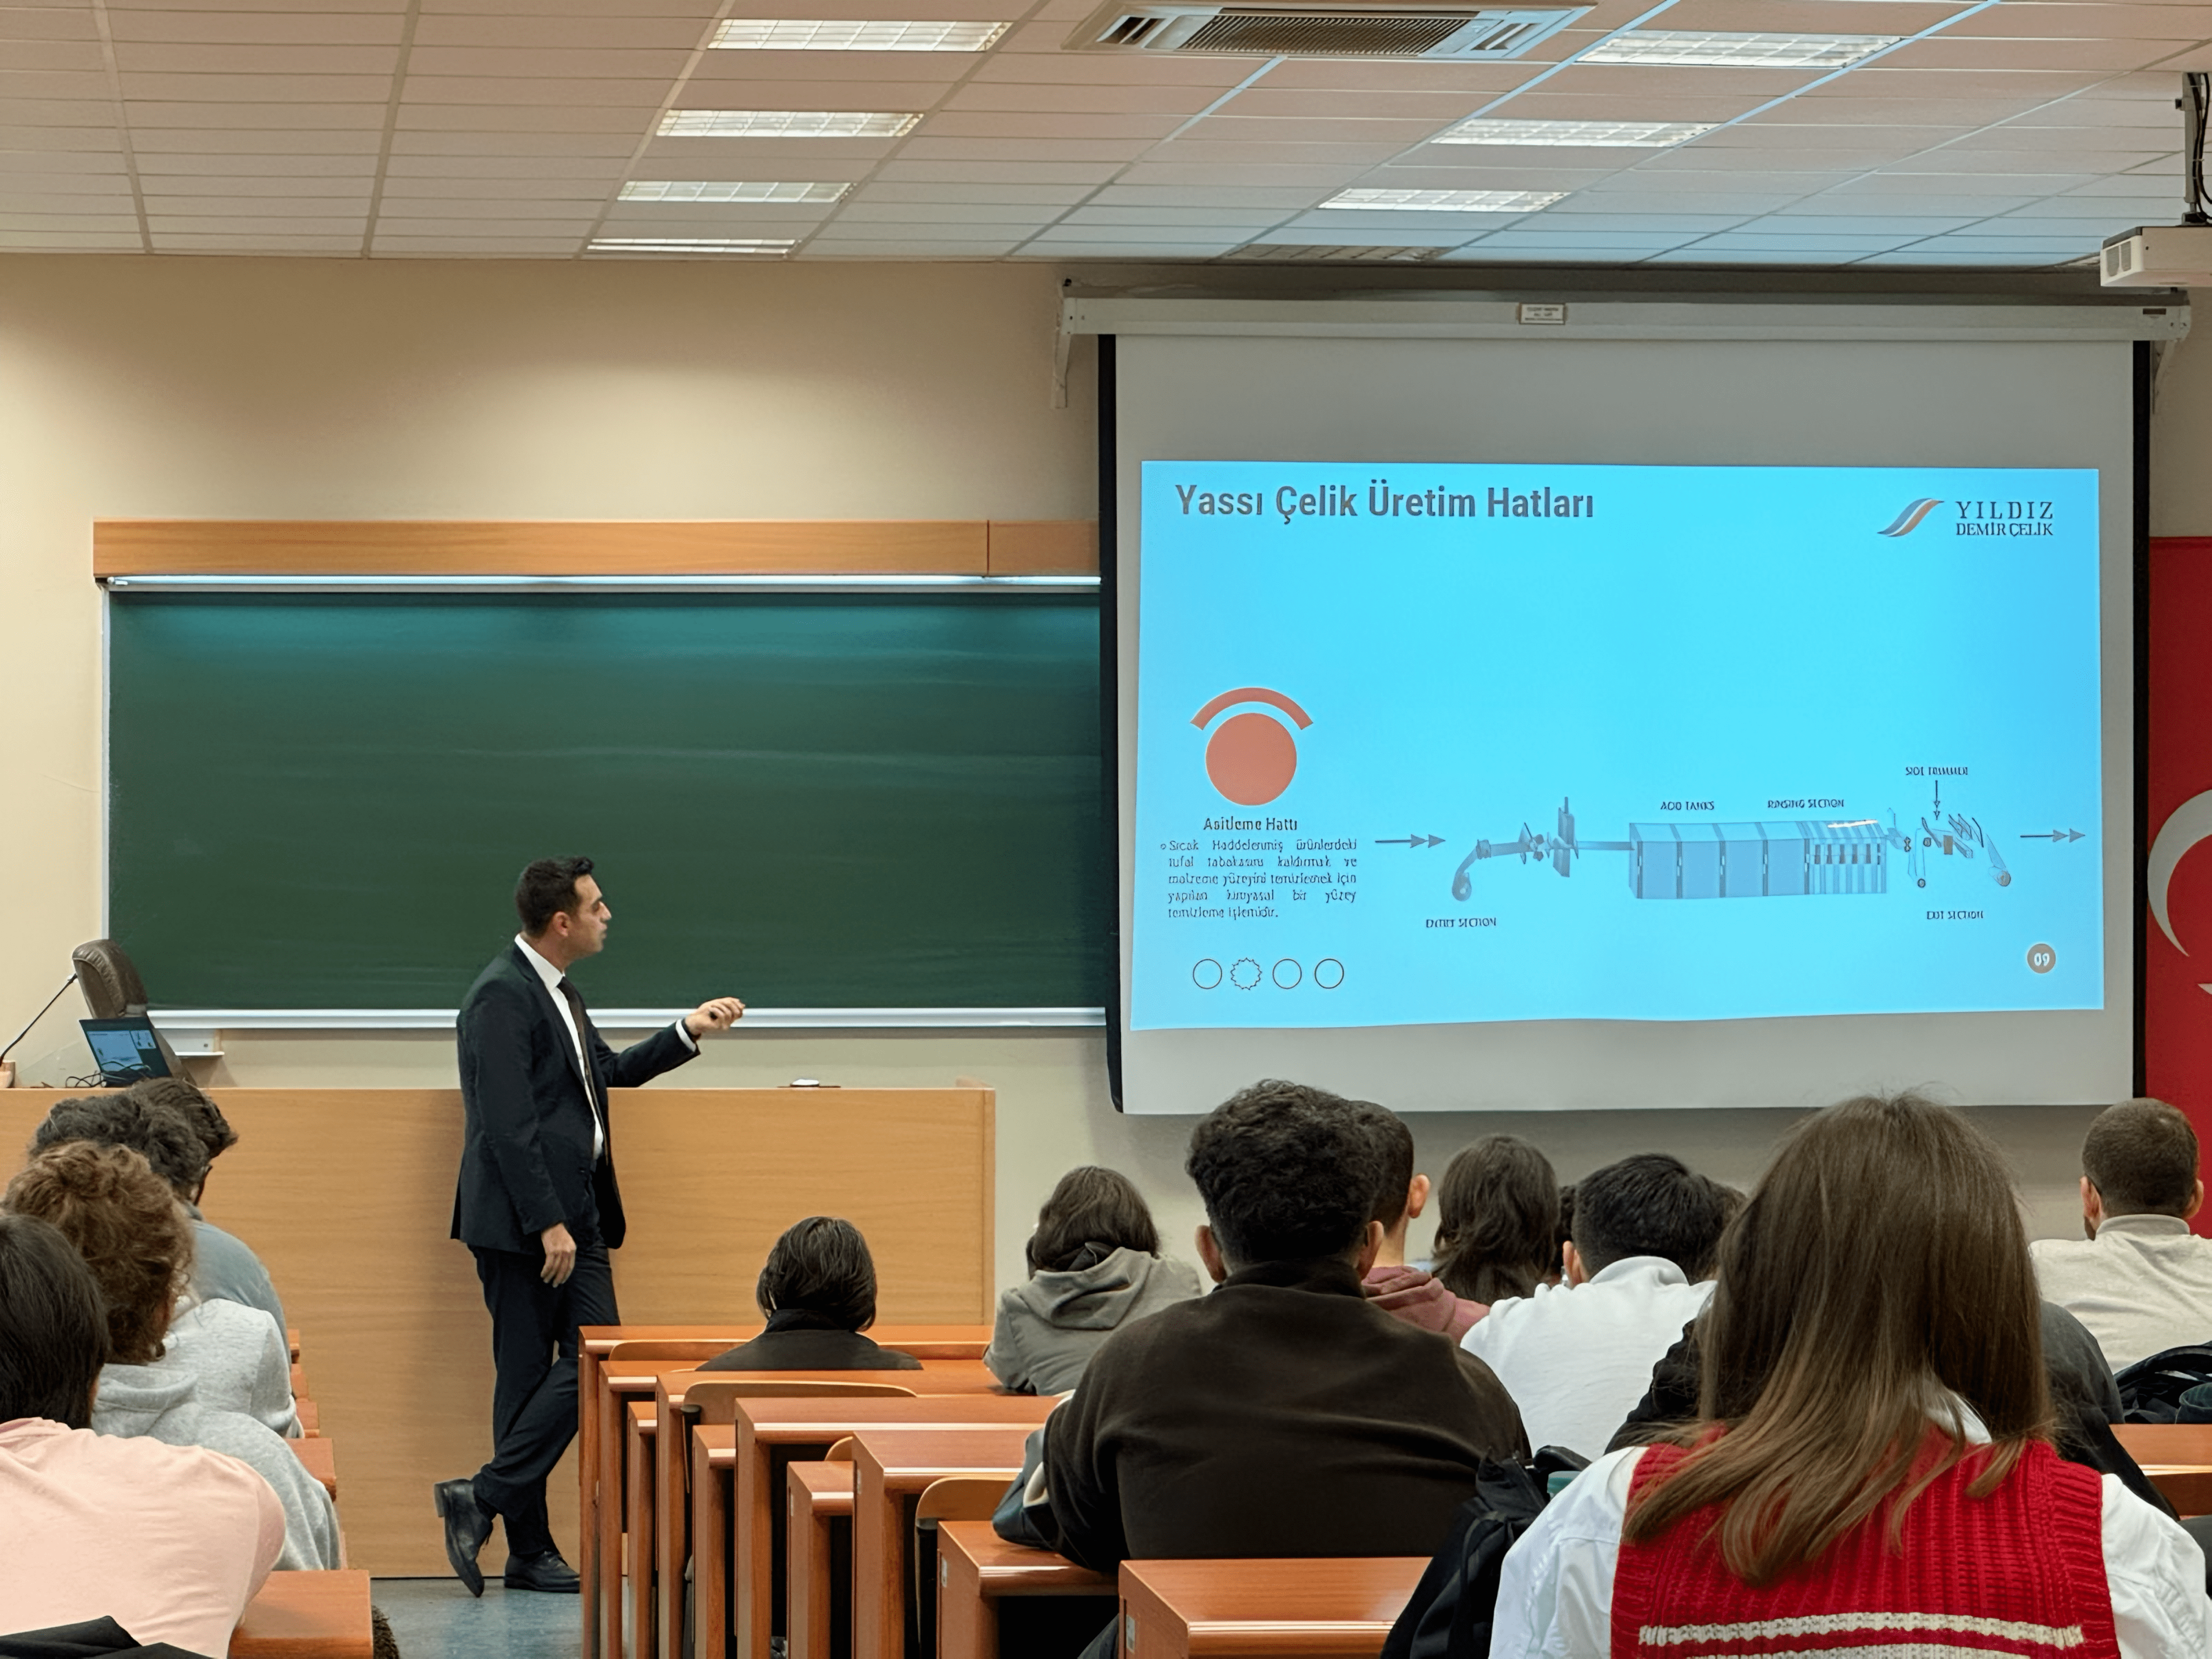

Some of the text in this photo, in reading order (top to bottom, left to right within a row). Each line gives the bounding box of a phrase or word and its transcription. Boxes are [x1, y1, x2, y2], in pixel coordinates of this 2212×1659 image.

[1175, 479, 1593, 525] Yassı Çelik Üretim Hatları
[1955, 501, 2053, 519] YILDIZ
[1956, 522, 2053, 537] DEMİR ÇELİK
[1266, 818, 1297, 831] Hattı
[2034, 953, 2050, 966] 09
